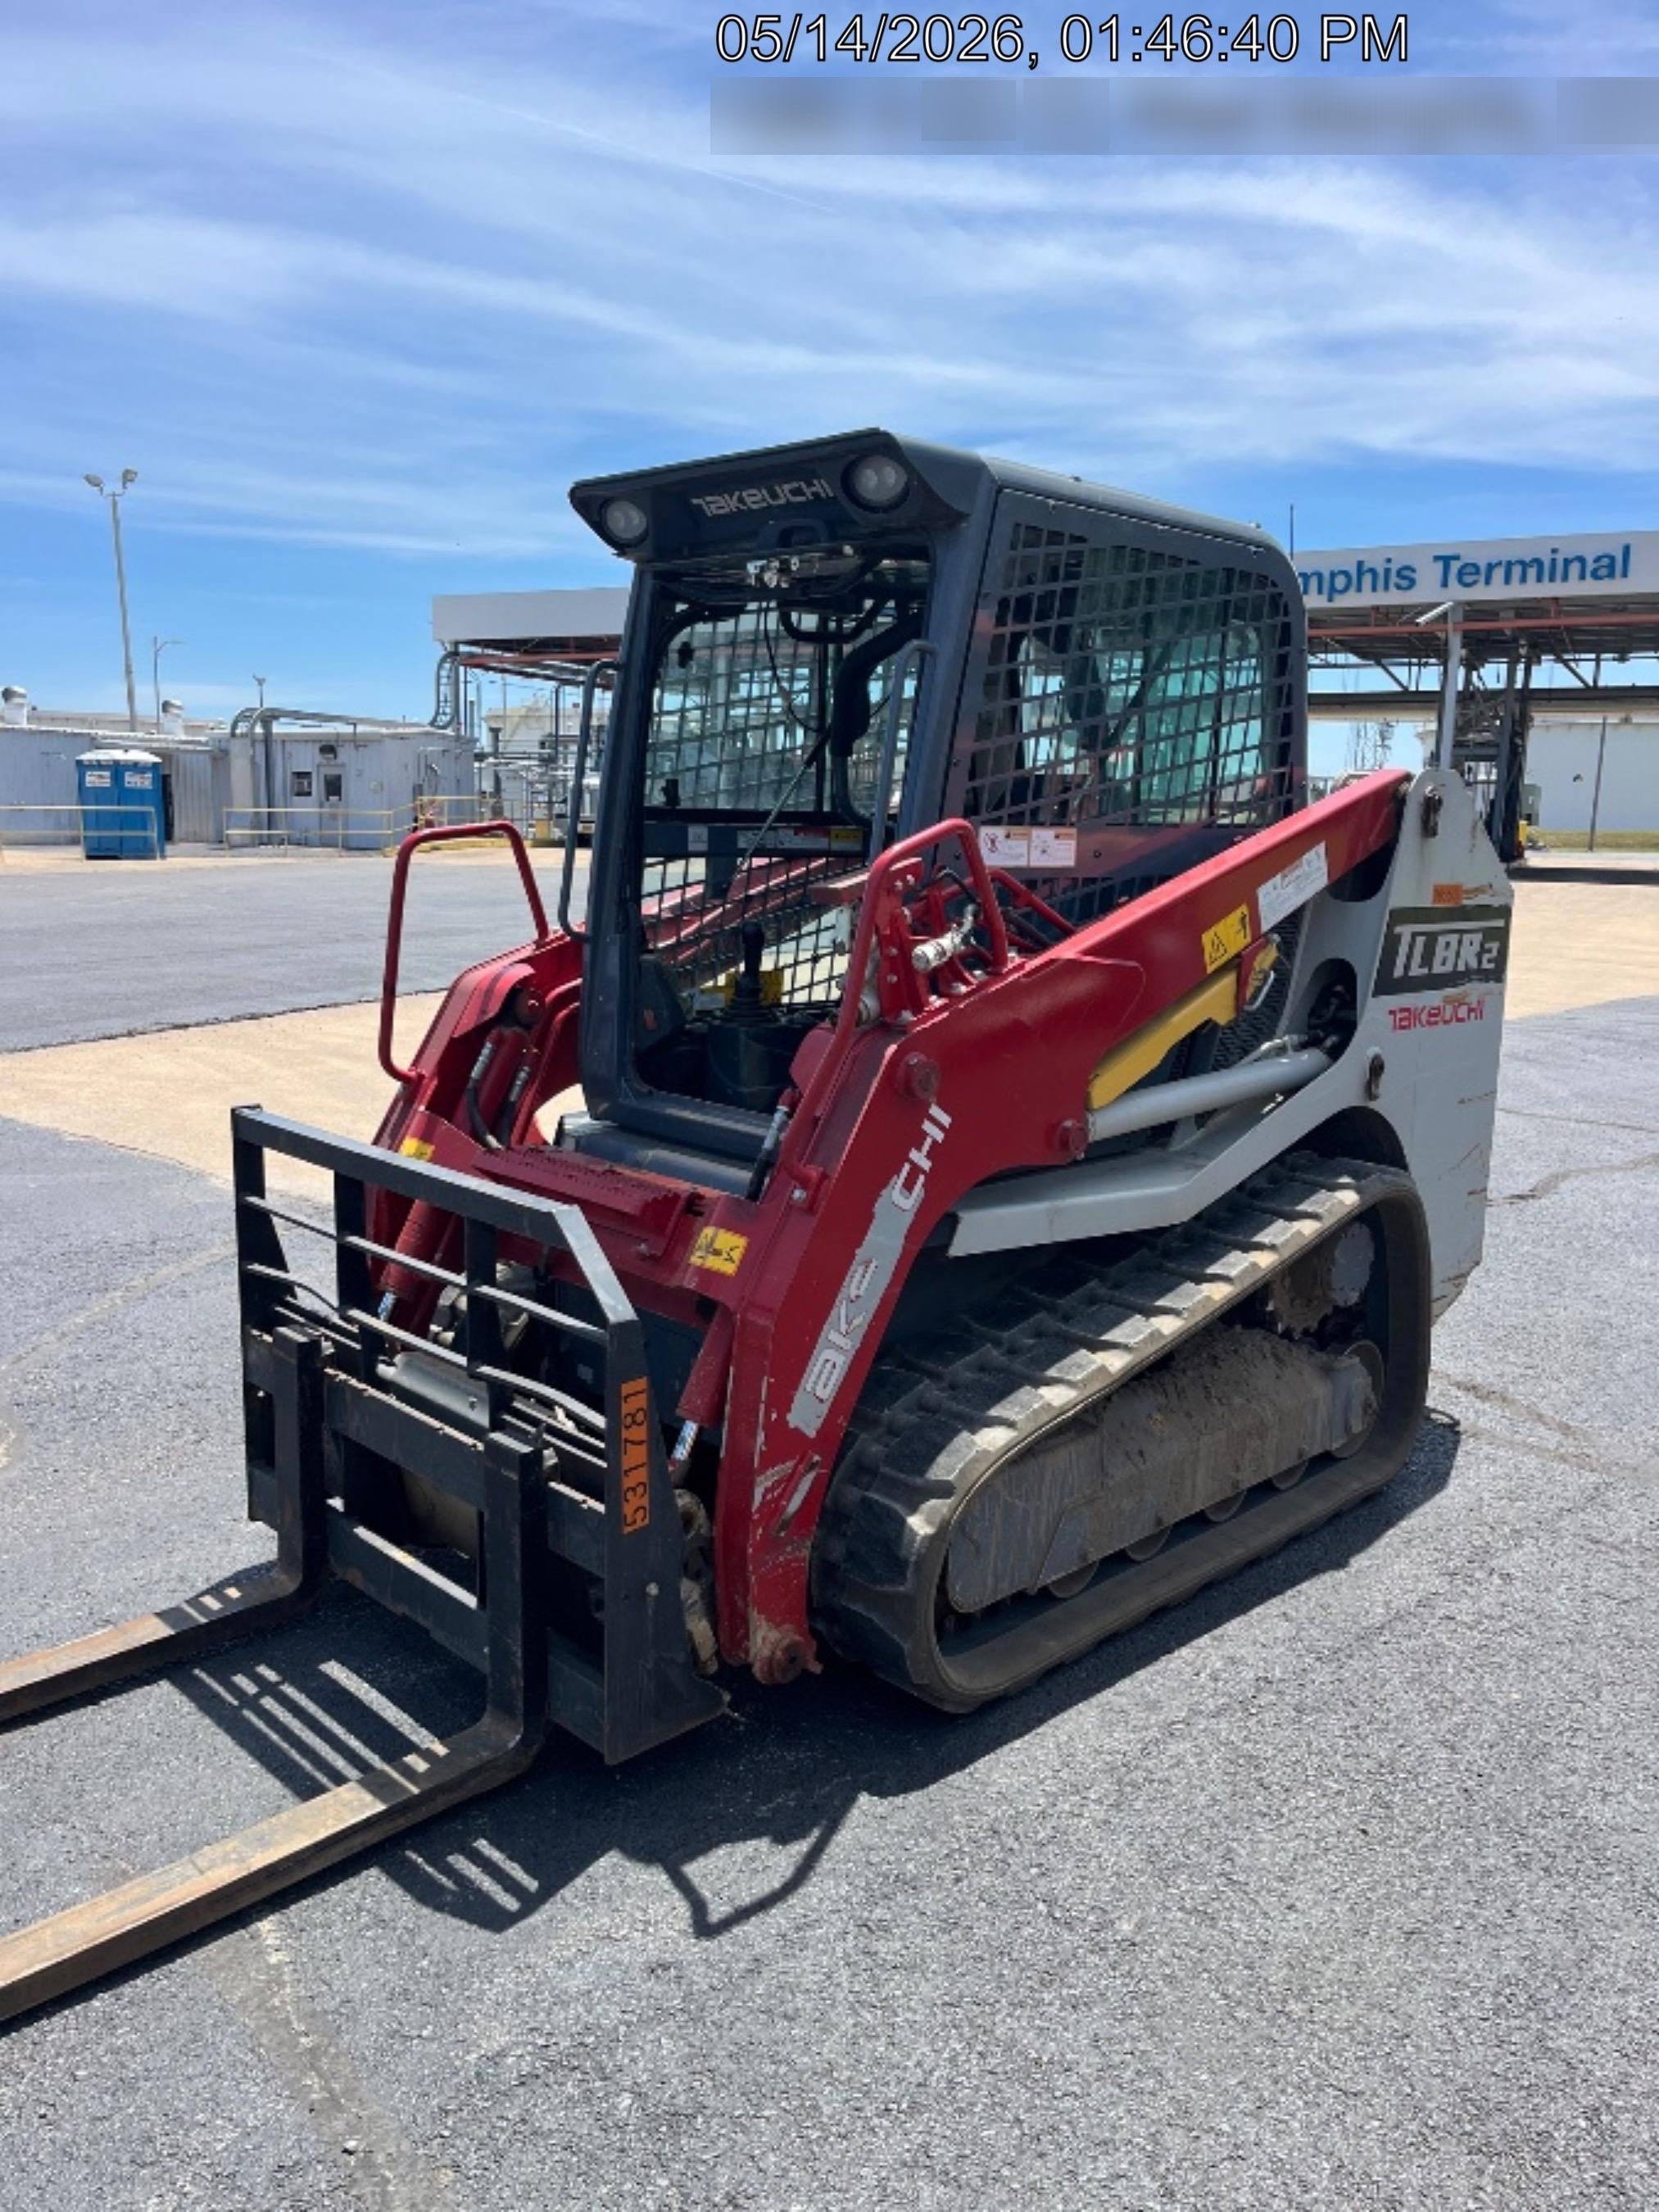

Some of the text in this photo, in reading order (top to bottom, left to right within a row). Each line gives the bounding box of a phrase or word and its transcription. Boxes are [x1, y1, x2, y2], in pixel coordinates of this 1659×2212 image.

[690, 478, 835, 517] TAKEUCHI
[1433, 543, 1631, 589] Terminal
[1387, 998, 1485, 1033] TAKEUCHI
[623, 1389, 648, 1527] 531781
